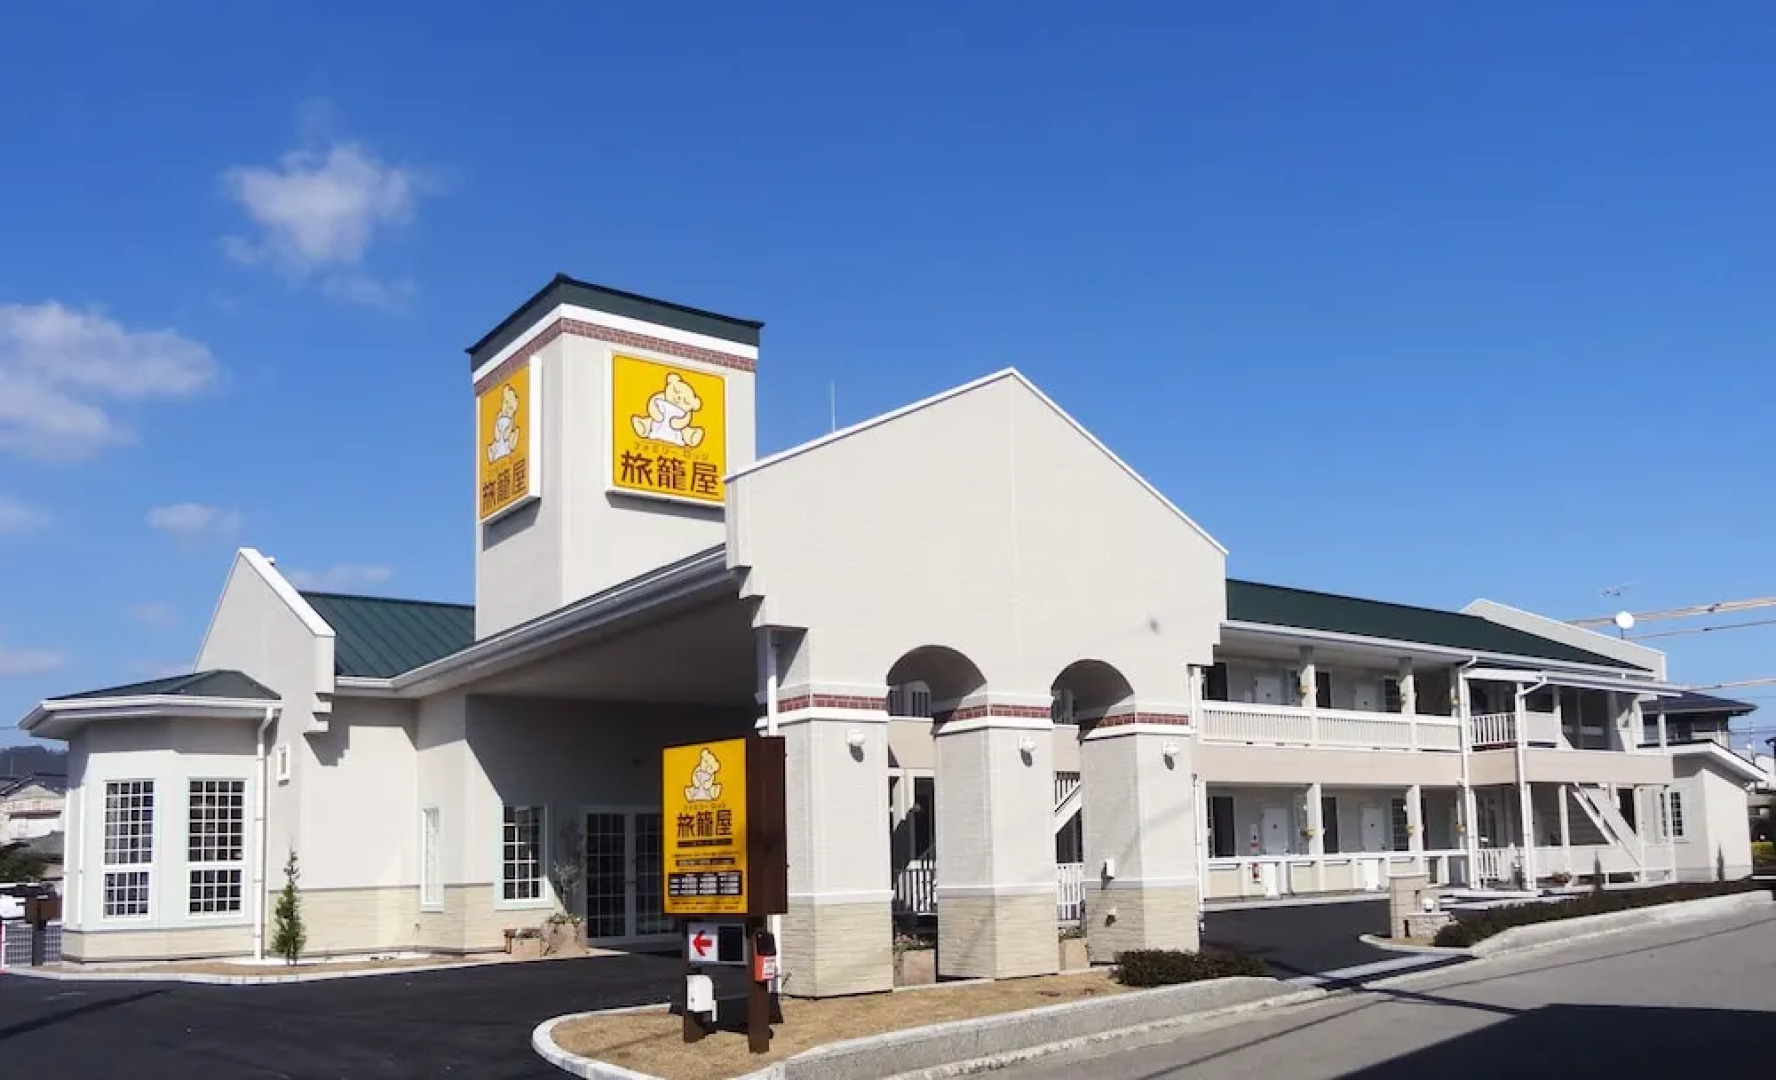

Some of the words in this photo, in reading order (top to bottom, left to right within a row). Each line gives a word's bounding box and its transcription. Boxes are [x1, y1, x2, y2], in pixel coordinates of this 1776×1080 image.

[482, 457, 527, 513] 旅籠屋
[620, 449, 720, 496] 旅籠屋
[677, 809, 733, 838] 旅籠屋
